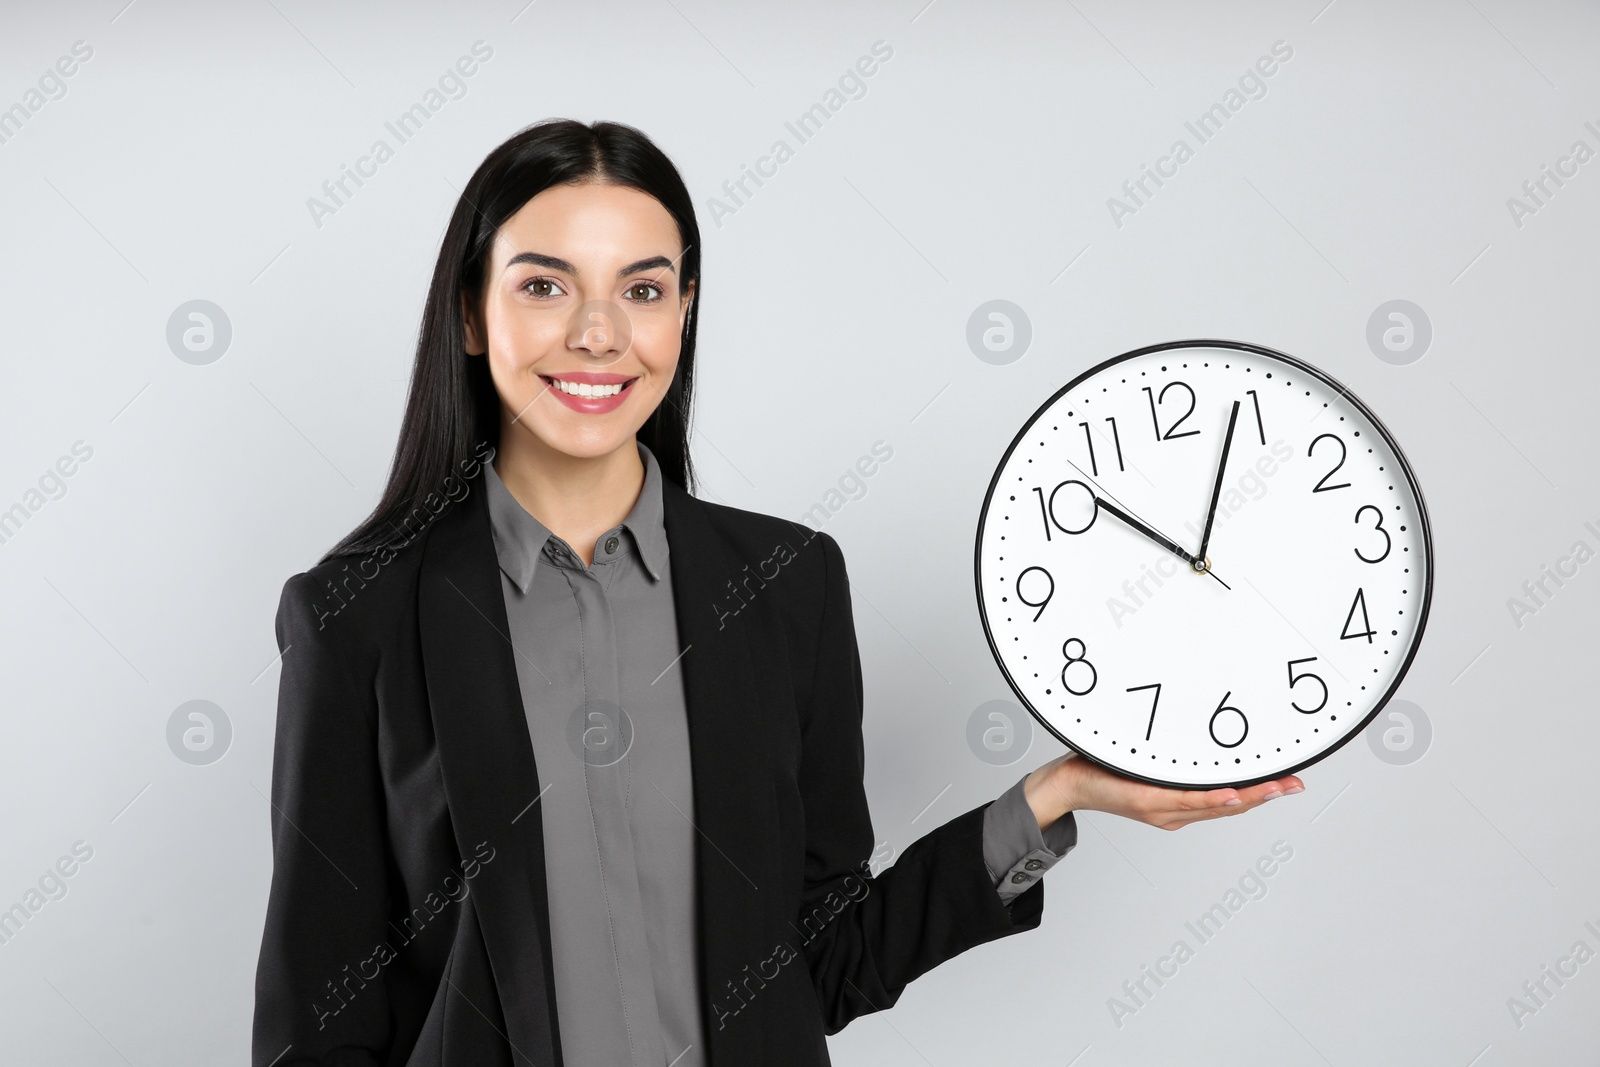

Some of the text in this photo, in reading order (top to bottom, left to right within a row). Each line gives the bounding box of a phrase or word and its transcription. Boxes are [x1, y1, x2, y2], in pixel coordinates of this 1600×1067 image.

[1142, 381, 1201, 442] 12
[1247, 390, 1265, 445] 1
[1079, 417, 1124, 477] 11
[1308, 434, 1351, 493] 2
[1033, 480, 1098, 542] 10
[1355, 505, 1391, 563] 3
[1016, 566, 1055, 622] 9
[1340, 588, 1377, 643] 4
[1062, 638, 1097, 696] 8
[1287, 657, 1328, 714] 5
[1126, 683, 1161, 740] 7
[1209, 691, 1249, 748] 6
